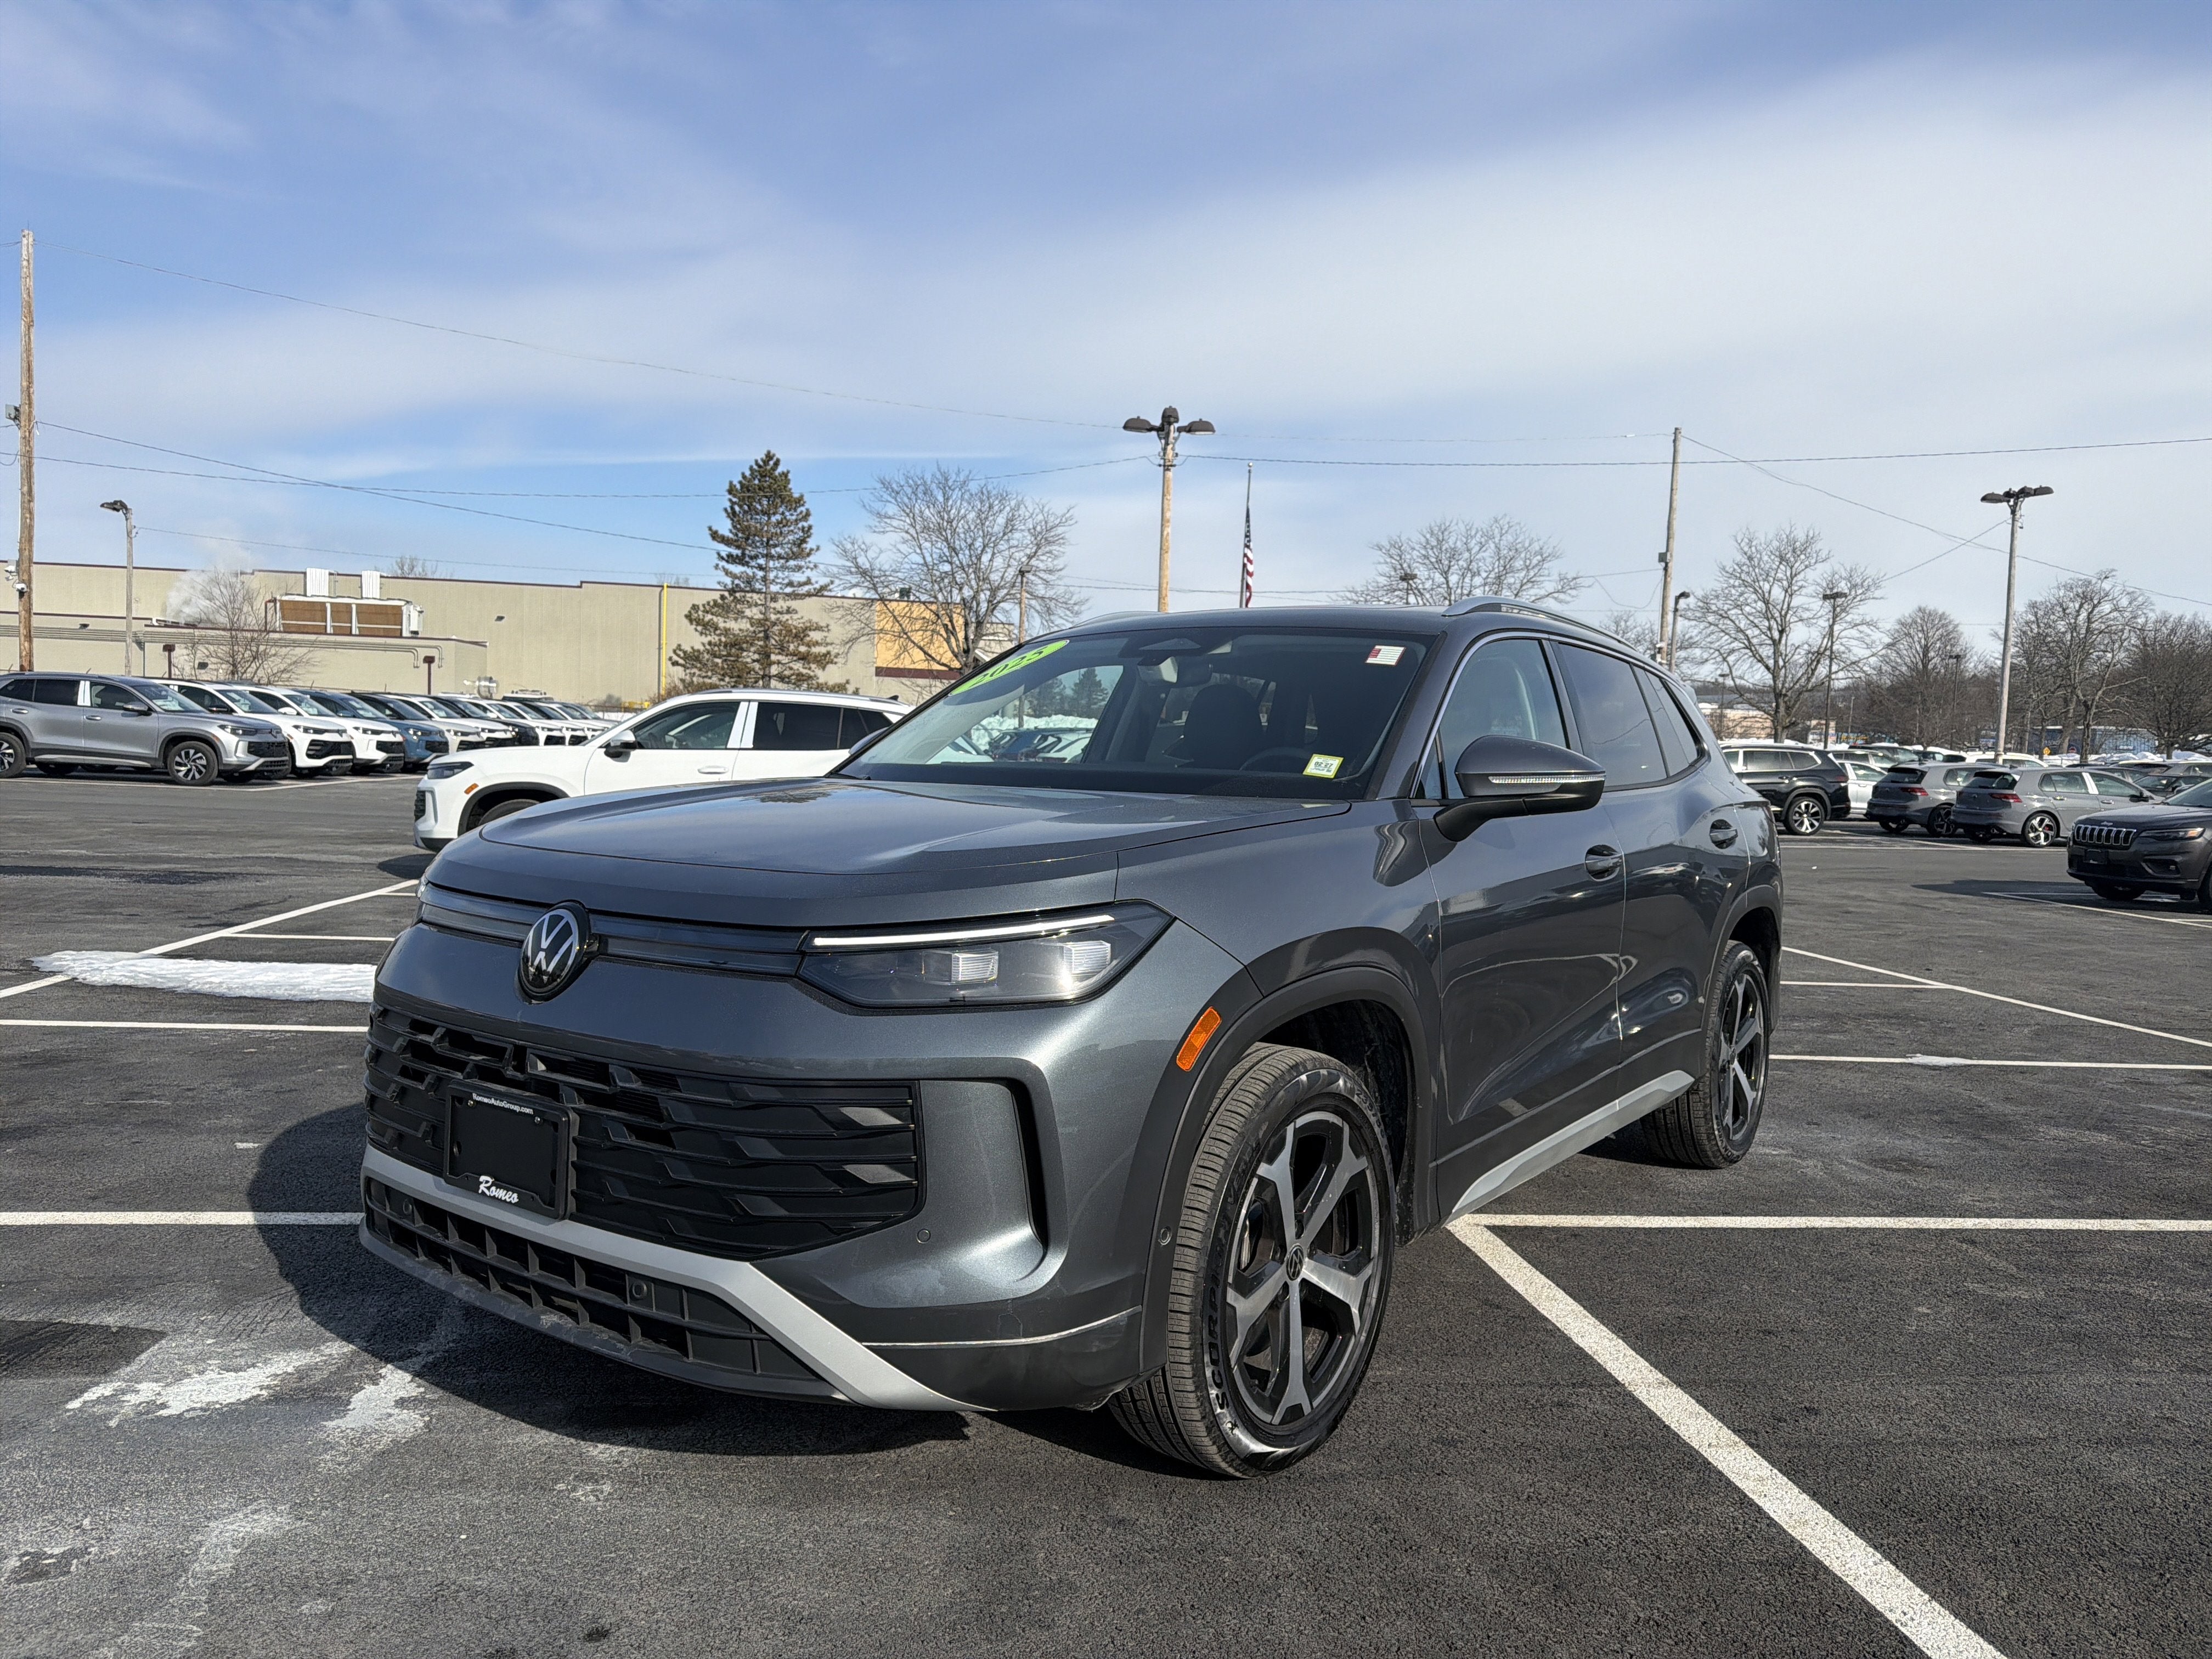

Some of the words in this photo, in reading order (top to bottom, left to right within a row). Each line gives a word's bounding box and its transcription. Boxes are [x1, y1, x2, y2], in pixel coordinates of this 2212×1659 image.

[969, 646, 1048, 688] 2025
[472, 1092, 534, 1115] RomeoAutoGroup.com
[478, 1175, 519, 1204] Romeo
